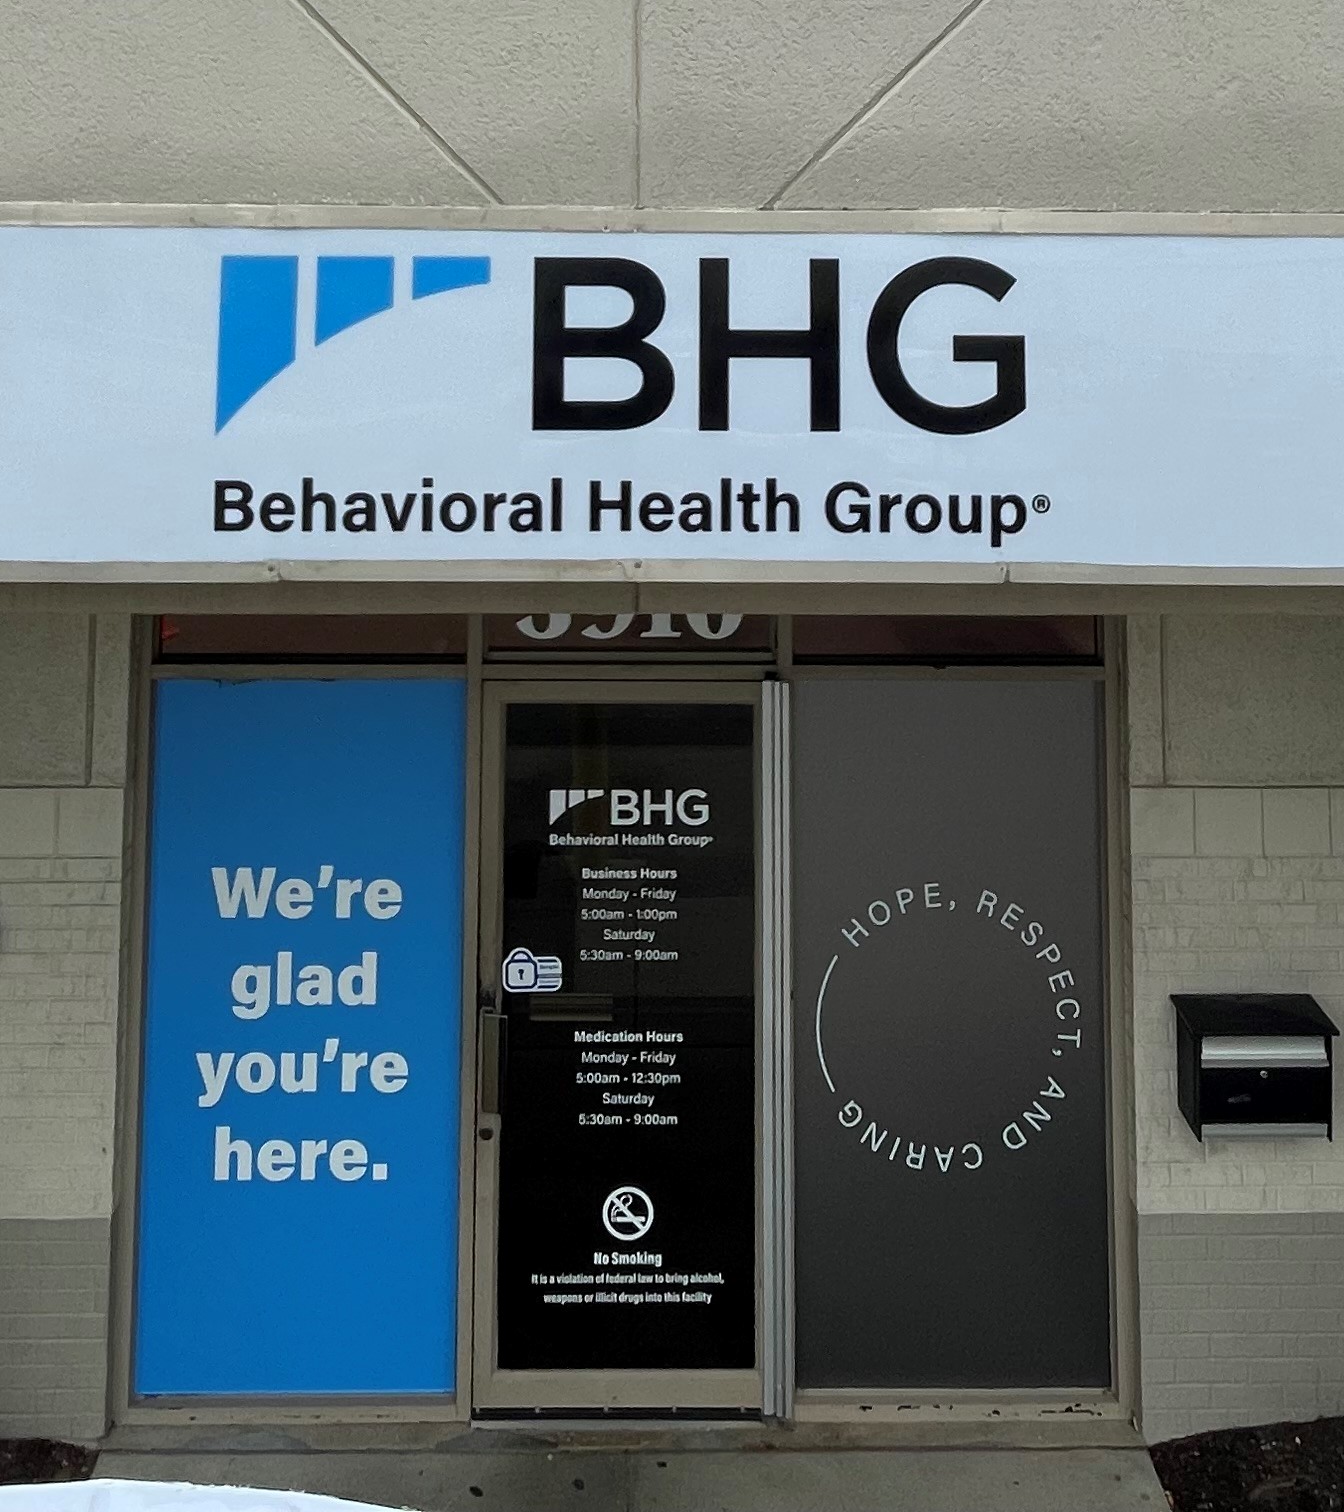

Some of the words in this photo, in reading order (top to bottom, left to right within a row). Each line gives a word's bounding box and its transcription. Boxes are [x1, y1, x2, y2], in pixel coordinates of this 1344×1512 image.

[531, 255, 1027, 436] BHG
[213, 477, 563, 532] Behavioral
[588, 479, 801, 534] Health
[610, 788, 710, 826] BHG
[549, 833, 619, 846] Behavioral
[622, 833, 665, 846] Health
[582, 867, 637, 879] Business
[640, 868, 678, 879] Hours
[582, 888, 630, 902] Monday
[640, 888, 677, 902] Friday
[581, 908, 625, 920] 5:00am
[636, 908, 678, 921] 1:00pm
[841, 882, 956, 948] HOPE,
[603, 928, 656, 943] Saturday
[580, 949, 624, 961] 5:30am
[634, 949, 679, 961] 9:00am
[976, 889, 1082, 1057] RESPECT,
[231, 951, 377, 1019] glad
[574, 1030, 643, 1042] Medication
[646, 1030, 684, 1042] Hours
[581, 1051, 629, 1066] Monday
[640, 1051, 676, 1066] Friday
[631, 1072, 681, 1086] 12:30pm
[602, 1092, 655, 1107] Saturday
[633, 1113, 678, 1125] 9:00am
[1001, 1075, 1066, 1150] AND
[837, 1099, 983, 1173] CARING
[214, 1126, 388, 1181] here.
[593, 1251, 609, 1265] No
[611, 1251, 662, 1268] Smoking
[549, 1275, 555, 1284] a
[556, 1272, 594, 1284] violation
[596, 1272, 604, 1284] of
[605, 1272, 636, 1284] federal
[638, 1272, 654, 1284] law
[655, 1273, 664, 1284] to
[665, 1272, 689, 1286] bring
[543, 1294, 583, 1305] weapons
[584, 1294, 594, 1303] or
[618, 1292, 644, 1305] drugs
[645, 1291, 662, 1303] into
[664, 1291, 680, 1303] this
[682, 1291, 712, 1304] facility
